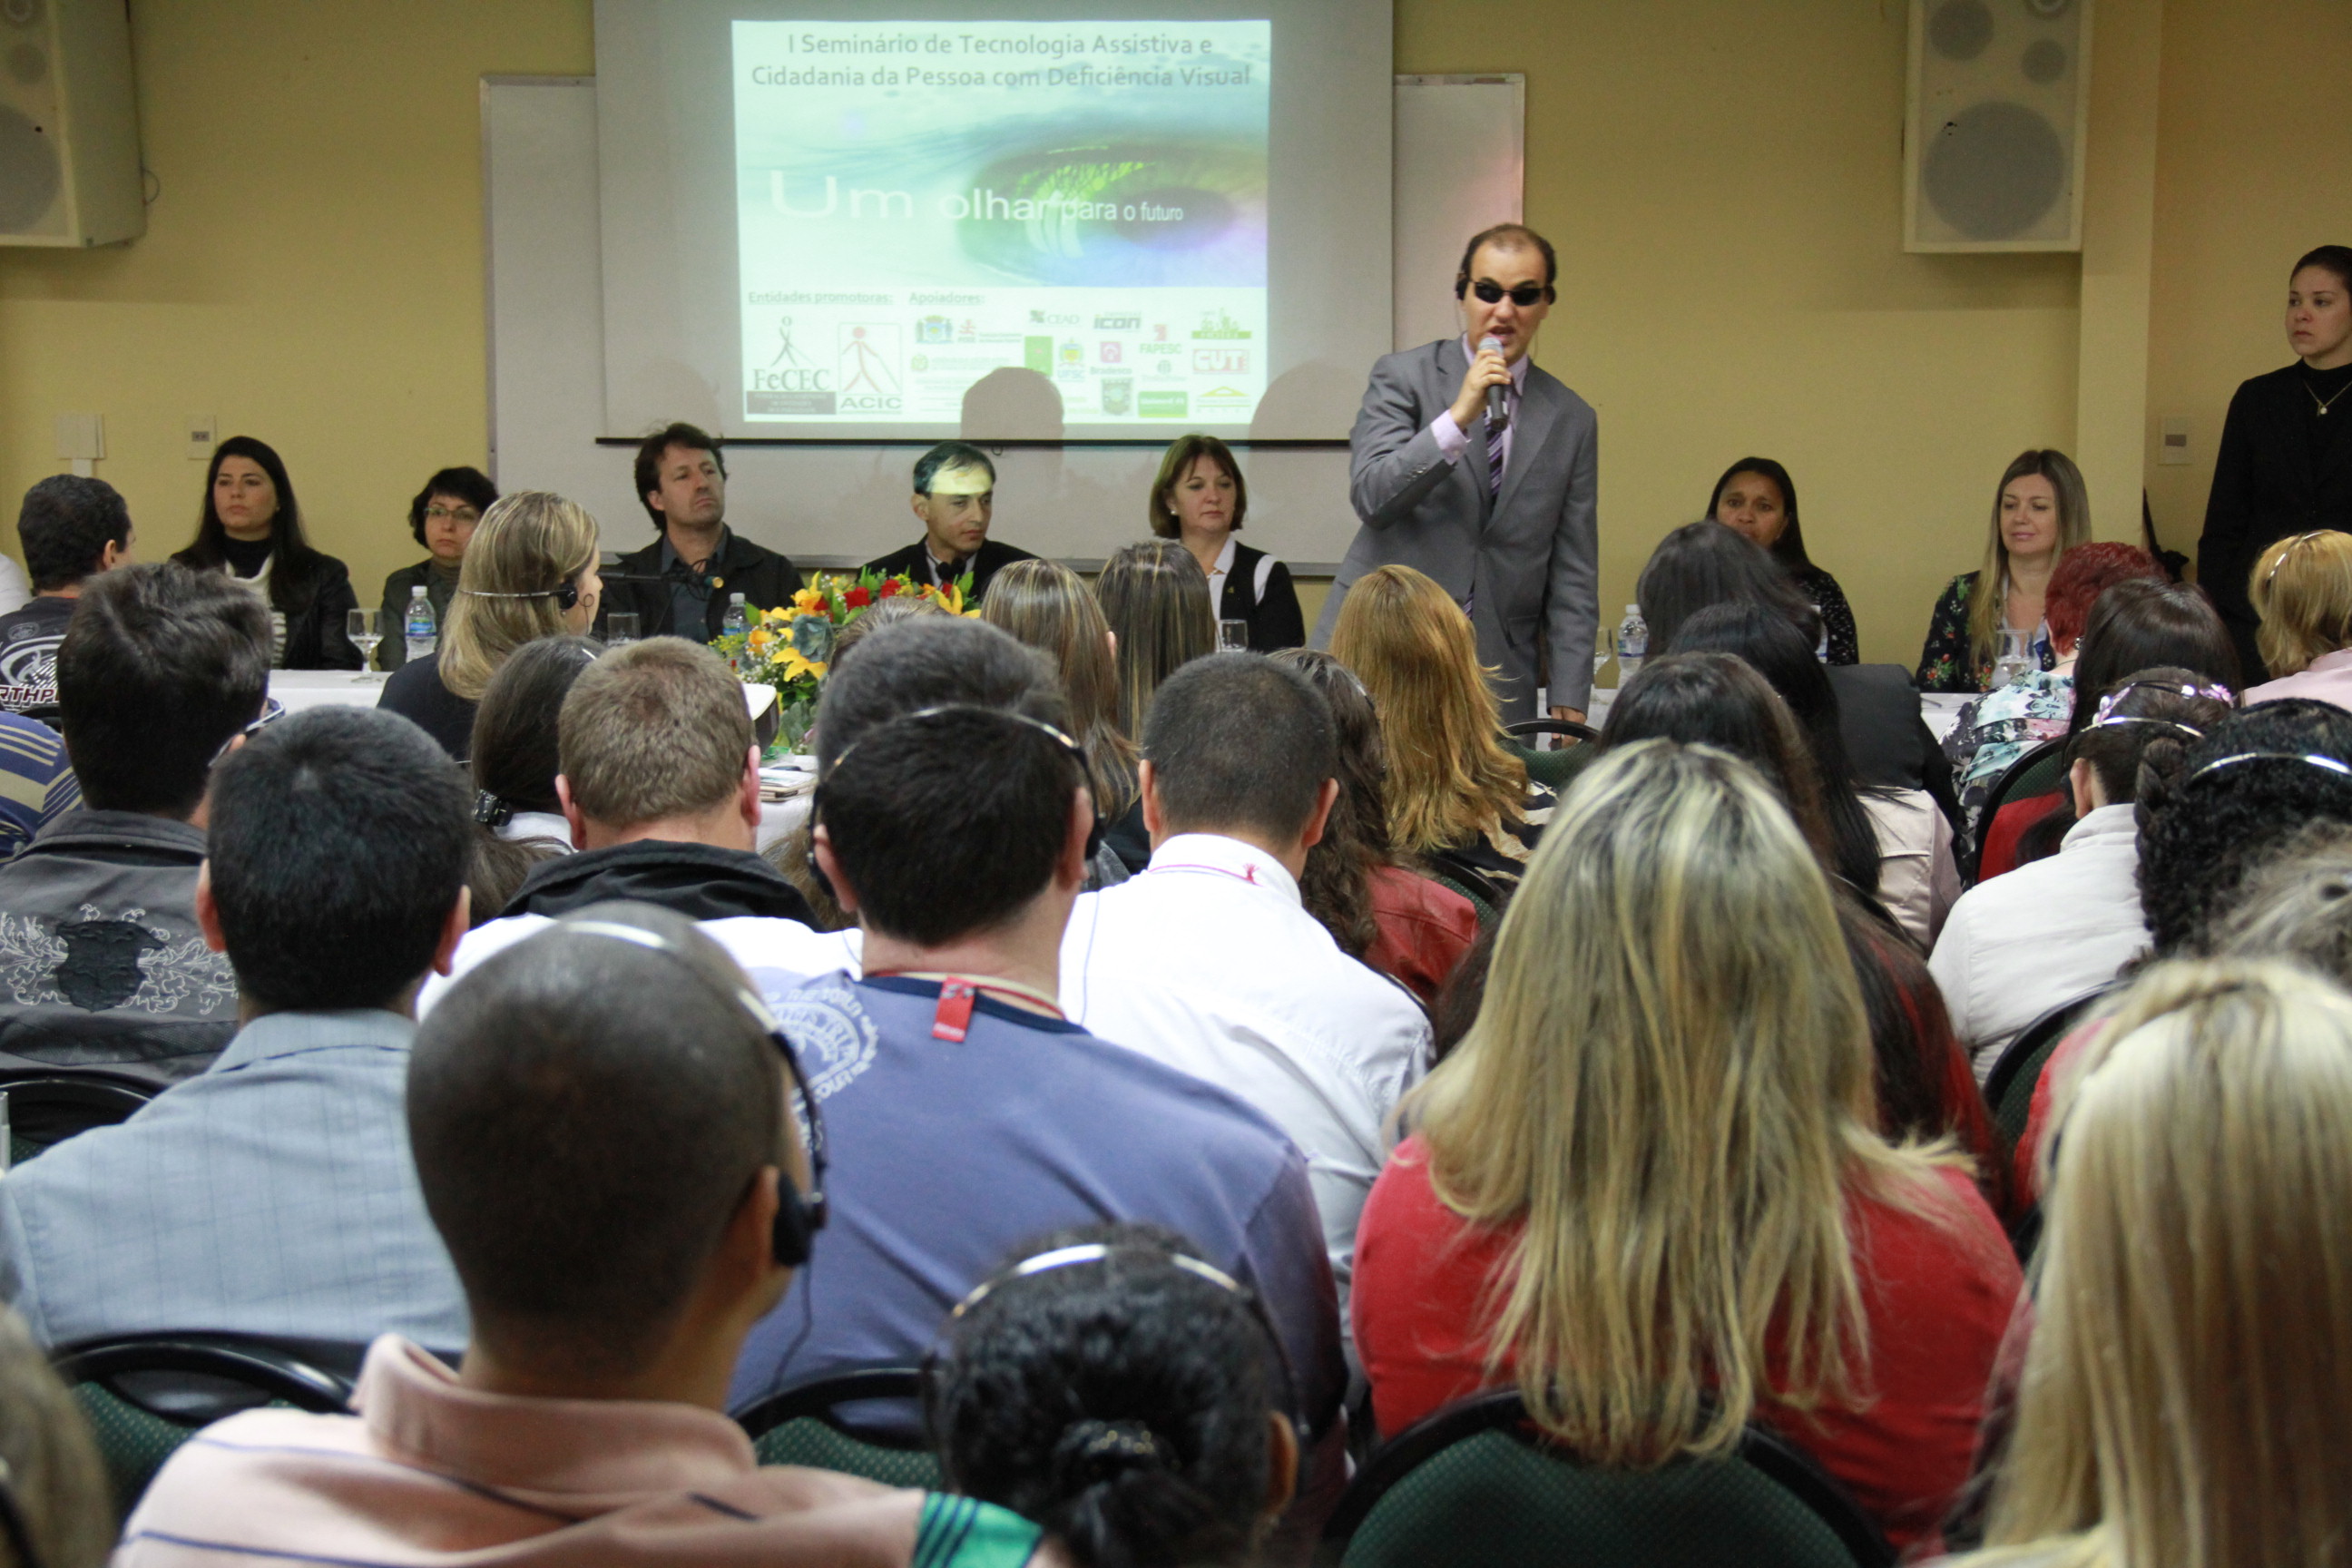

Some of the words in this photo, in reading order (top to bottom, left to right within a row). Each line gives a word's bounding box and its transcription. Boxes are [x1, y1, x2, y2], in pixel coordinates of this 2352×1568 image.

[801, 34, 918, 54] Seminário
[925, 34, 952, 54] de
[958, 34, 1085, 60] Tecnologia
[1093, 34, 1194, 54] Assistiva
[1200, 40, 1212, 54] e
[751, 66, 866, 87] Cidadania
[872, 66, 899, 87] da
[906, 67, 985, 87] Pessoa
[993, 73, 1041, 87] com
[1048, 66, 1173, 87] Deficiência
[1179, 66, 1250, 87] Visual
[769, 170, 913, 220] Um
[939, 188, 1049, 221] olhar
[1061, 198, 1118, 225] para
[1123, 205, 1136, 221] o
[1141, 201, 1184, 221] futuro
[749, 291, 811, 304] Entidades
[815, 290, 893, 305] promotoras:
[909, 291, 985, 306] Apoiadores:
[1093, 314, 1142, 329] icon
[1140, 343, 1182, 355] FAPESC
[753, 368, 830, 392] FeCEC
[840, 397, 903, 409] ACIC
[0, 685, 60, 703] RTHP
